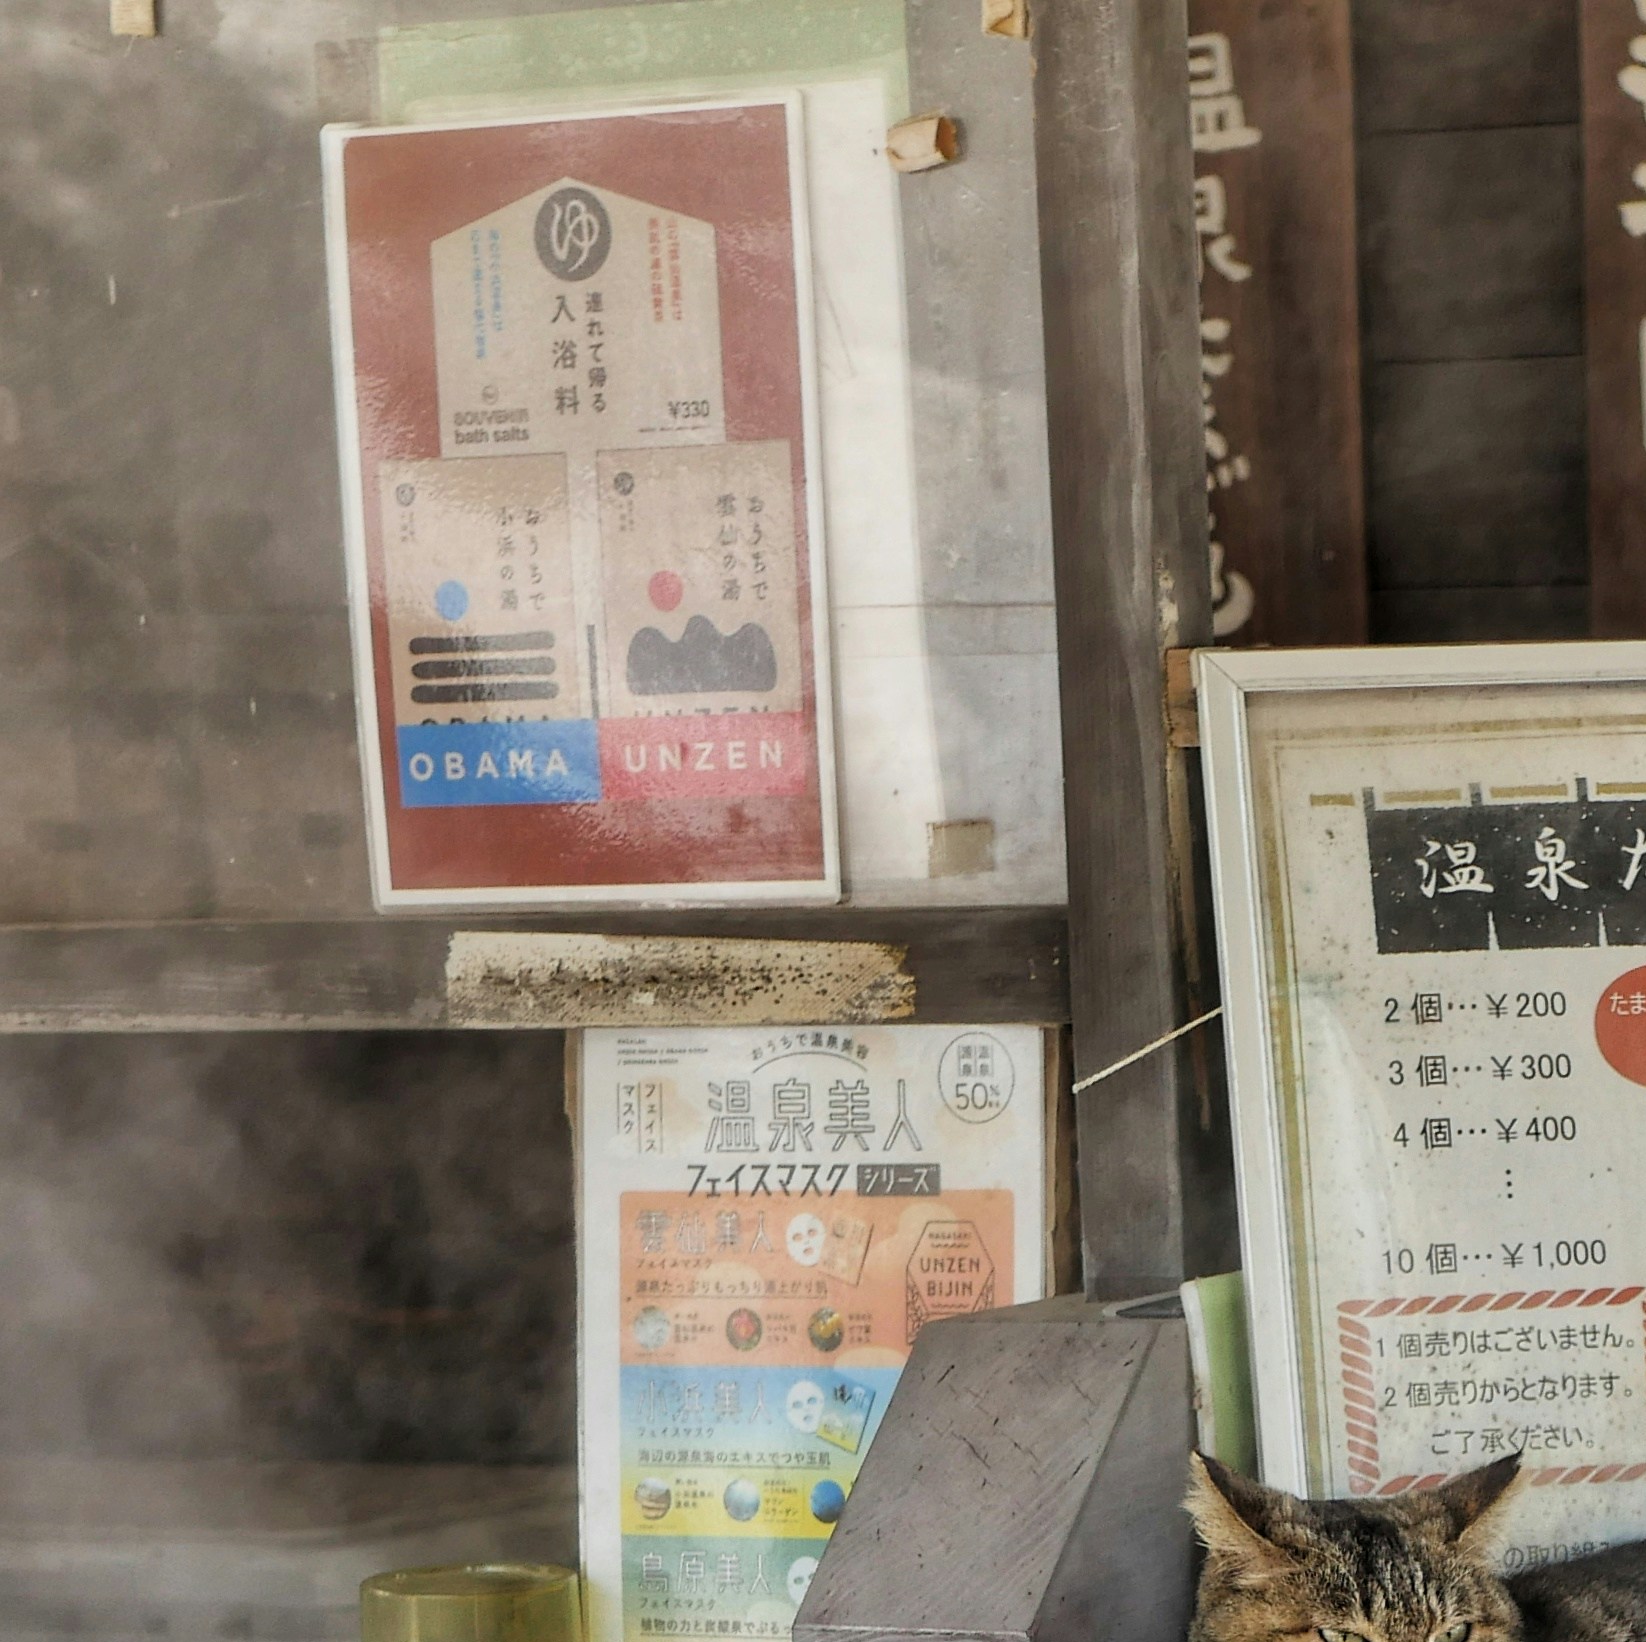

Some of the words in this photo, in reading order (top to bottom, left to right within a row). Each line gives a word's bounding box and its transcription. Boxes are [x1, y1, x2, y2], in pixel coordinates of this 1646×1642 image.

[551, 294, 580, 415] 入浴料
[409, 748, 569, 782] OBAMA
[624, 739, 784, 774] UNZEN
[703, 1077, 923, 1152] 温泉美人
[686, 1162, 850, 1197] フェイスマスク
[863, 1164, 938, 1194] シリーズ
[920, 1258, 980, 1273] UNZEN
[927, 1280, 973, 1297] BIJIN
[1431, 1426, 1596, 1456] ご了承ください。
[639, 1551, 772, 1596] 島原美人
